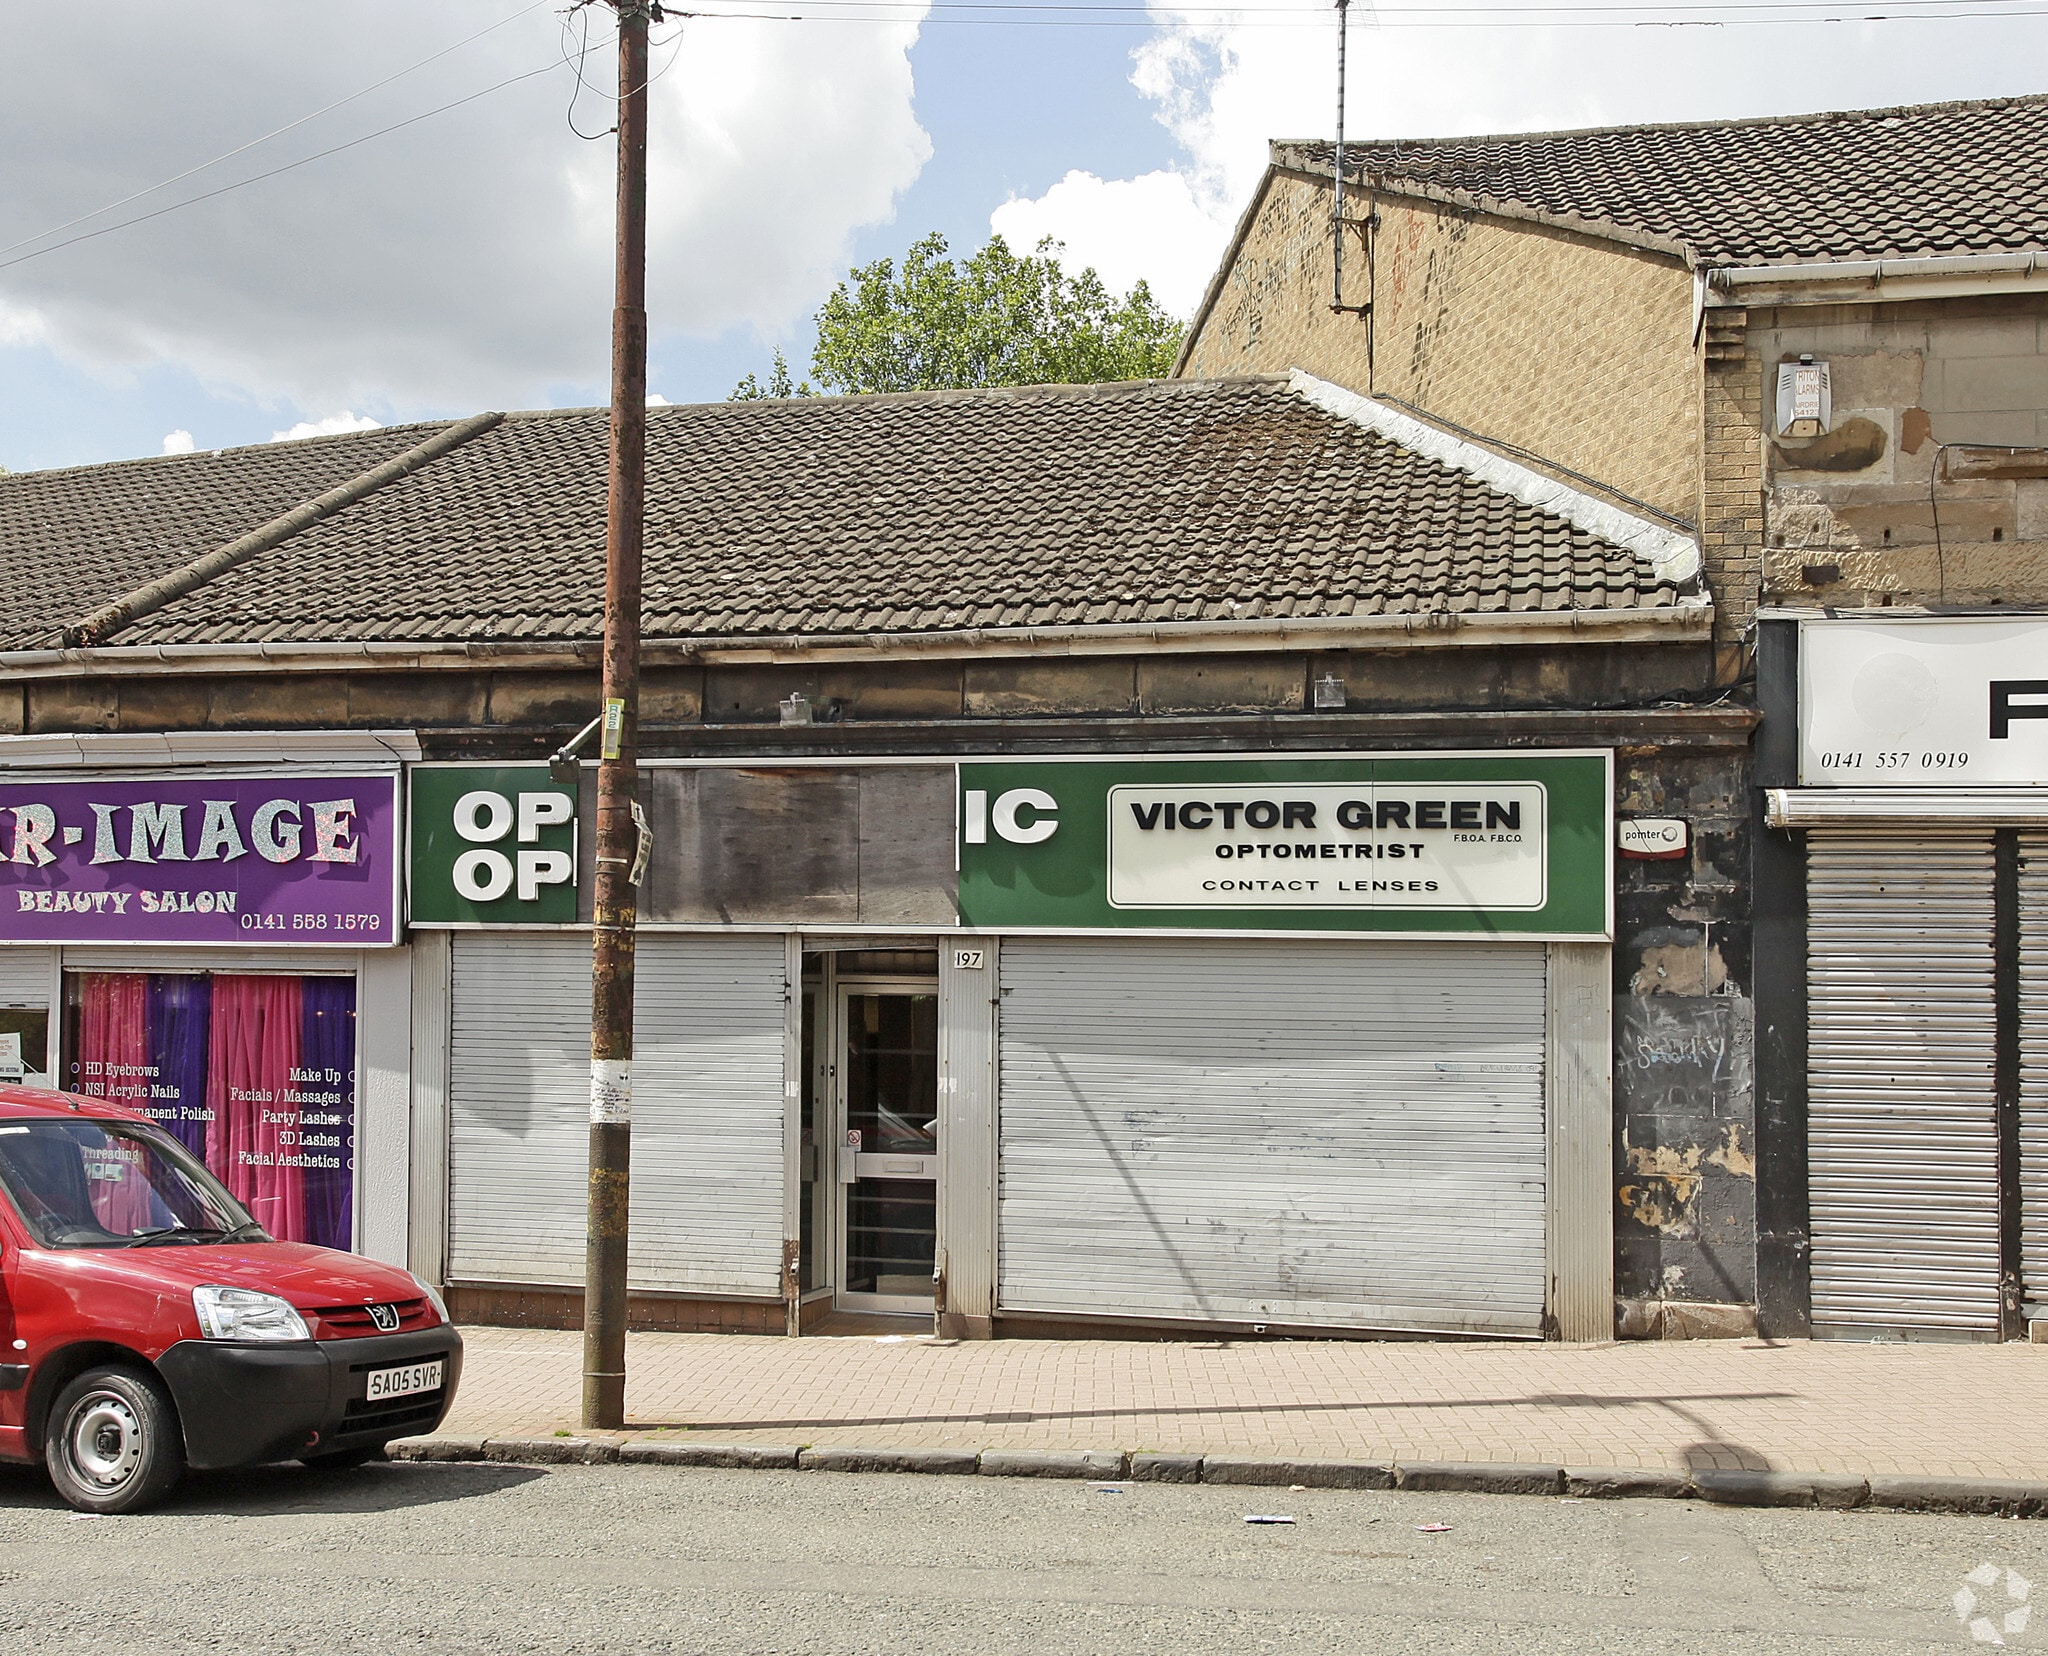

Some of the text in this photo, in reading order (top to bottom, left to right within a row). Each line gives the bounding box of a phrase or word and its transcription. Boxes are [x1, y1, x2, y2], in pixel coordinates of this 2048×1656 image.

[1821, 752, 1969, 768] 0141 557 0919
[965, 788, 1059, 845] IC
[1130, 801, 1521, 831] VICTOR GREEN
[0, 798, 360, 868] R-IMAGE
[1625, 829, 1661, 840] pointer
[1215, 843, 1425, 860] OPTOMETRIST
[452, 849, 573, 901] OP
[1202, 879, 1439, 892] CONTACT LENSES
[17, 890, 238, 914] BEAUTY SALON
[241, 913, 381, 931] 0141 558 1579
[956, 952, 981, 967] 197
[85, 1061, 160, 1078] HD Eyebrows
[289, 1067, 341, 1085] Make Up
[85, 1082, 180, 1099] NSI Acrylic Nails
[230, 1087, 341, 1106] Facials / Massages
[128, 1106, 216, 1120] manent Polish
[262, 1109, 341, 1126] Party Lashes
[280, 1131, 340, 1147] 3D Lashes
[82, 1147, 139, 1163] Threading
[238, 1150, 340, 1168] Facial Aesthetics
[371, 1366, 437, 1395] SA05 SVR
